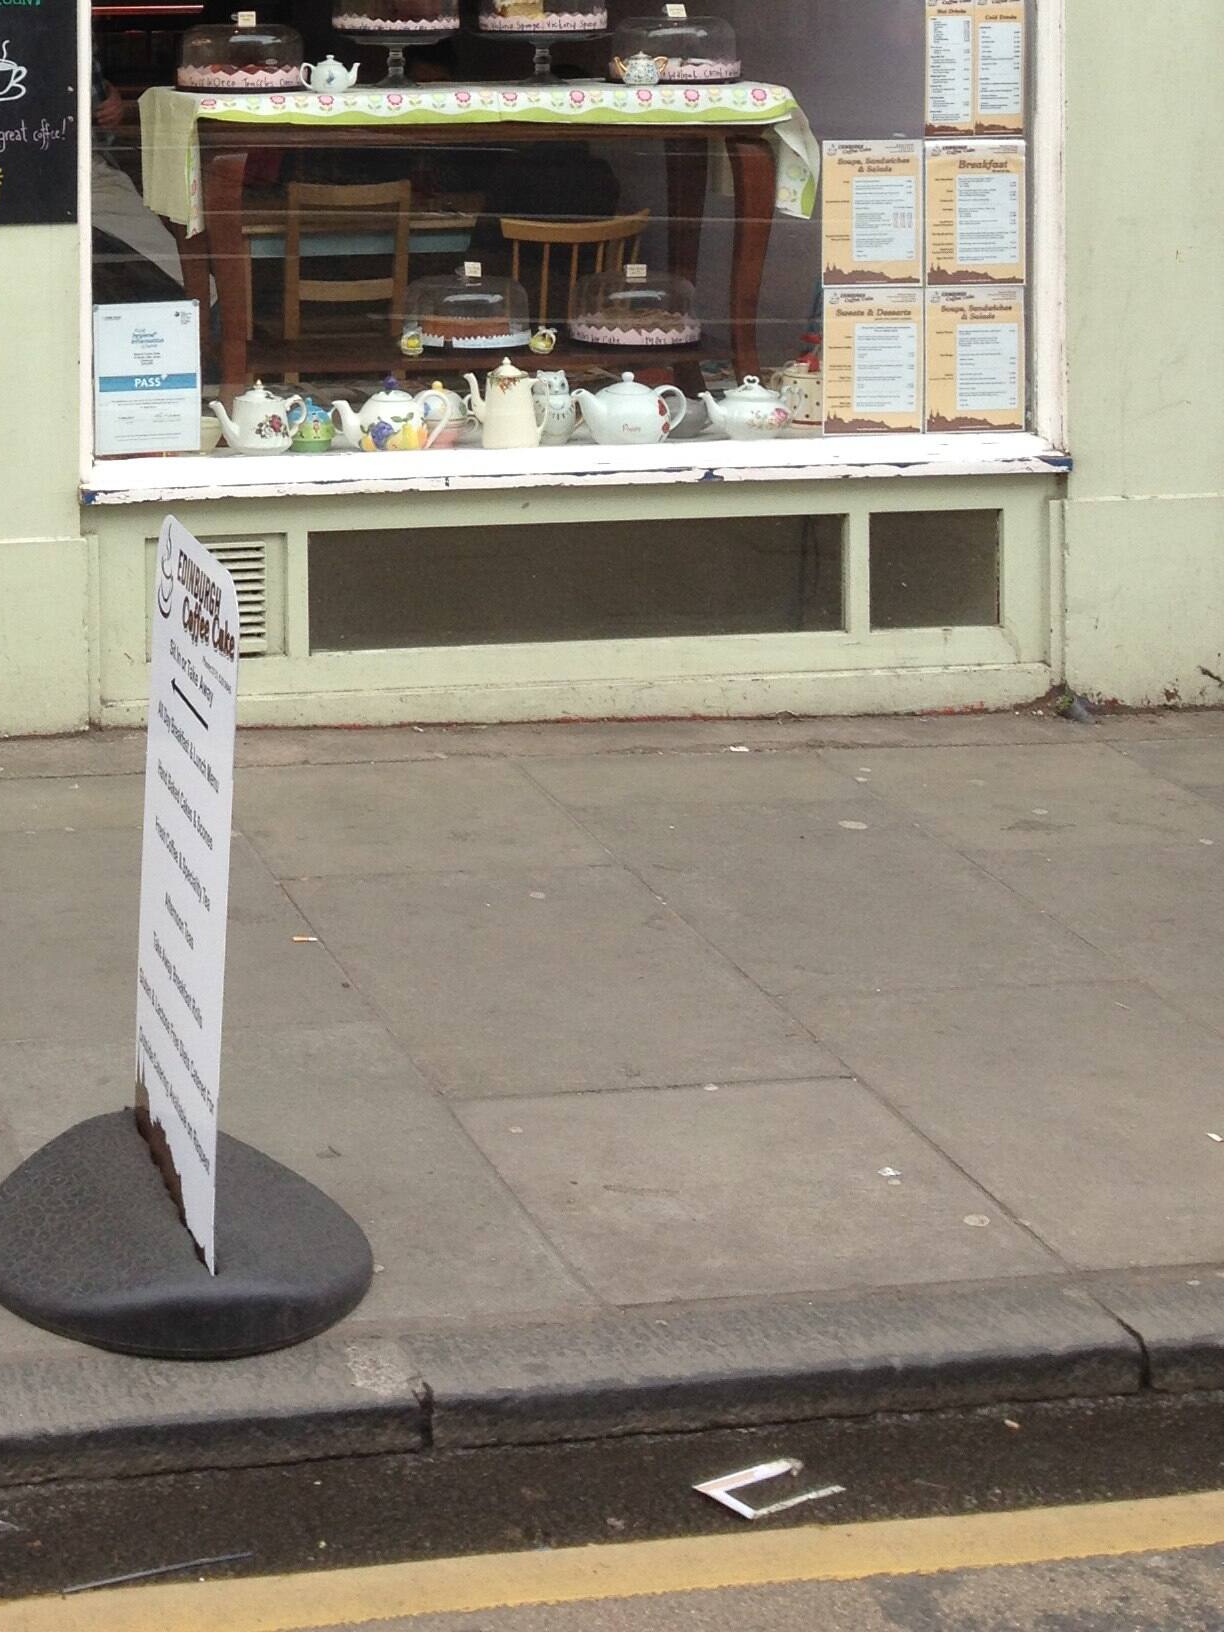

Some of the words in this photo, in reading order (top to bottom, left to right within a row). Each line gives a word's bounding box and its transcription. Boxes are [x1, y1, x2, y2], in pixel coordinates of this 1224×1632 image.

[958, 159, 1008, 170] Breakfast
[134, 376, 162, 388] PASS
[177, 549, 222, 617] EDINBURGH
[182, 596, 210, 646] Coffee
[212, 615, 235, 662] Cake
[187, 658, 198, 687] Take
[198, 674, 214, 708] Away
